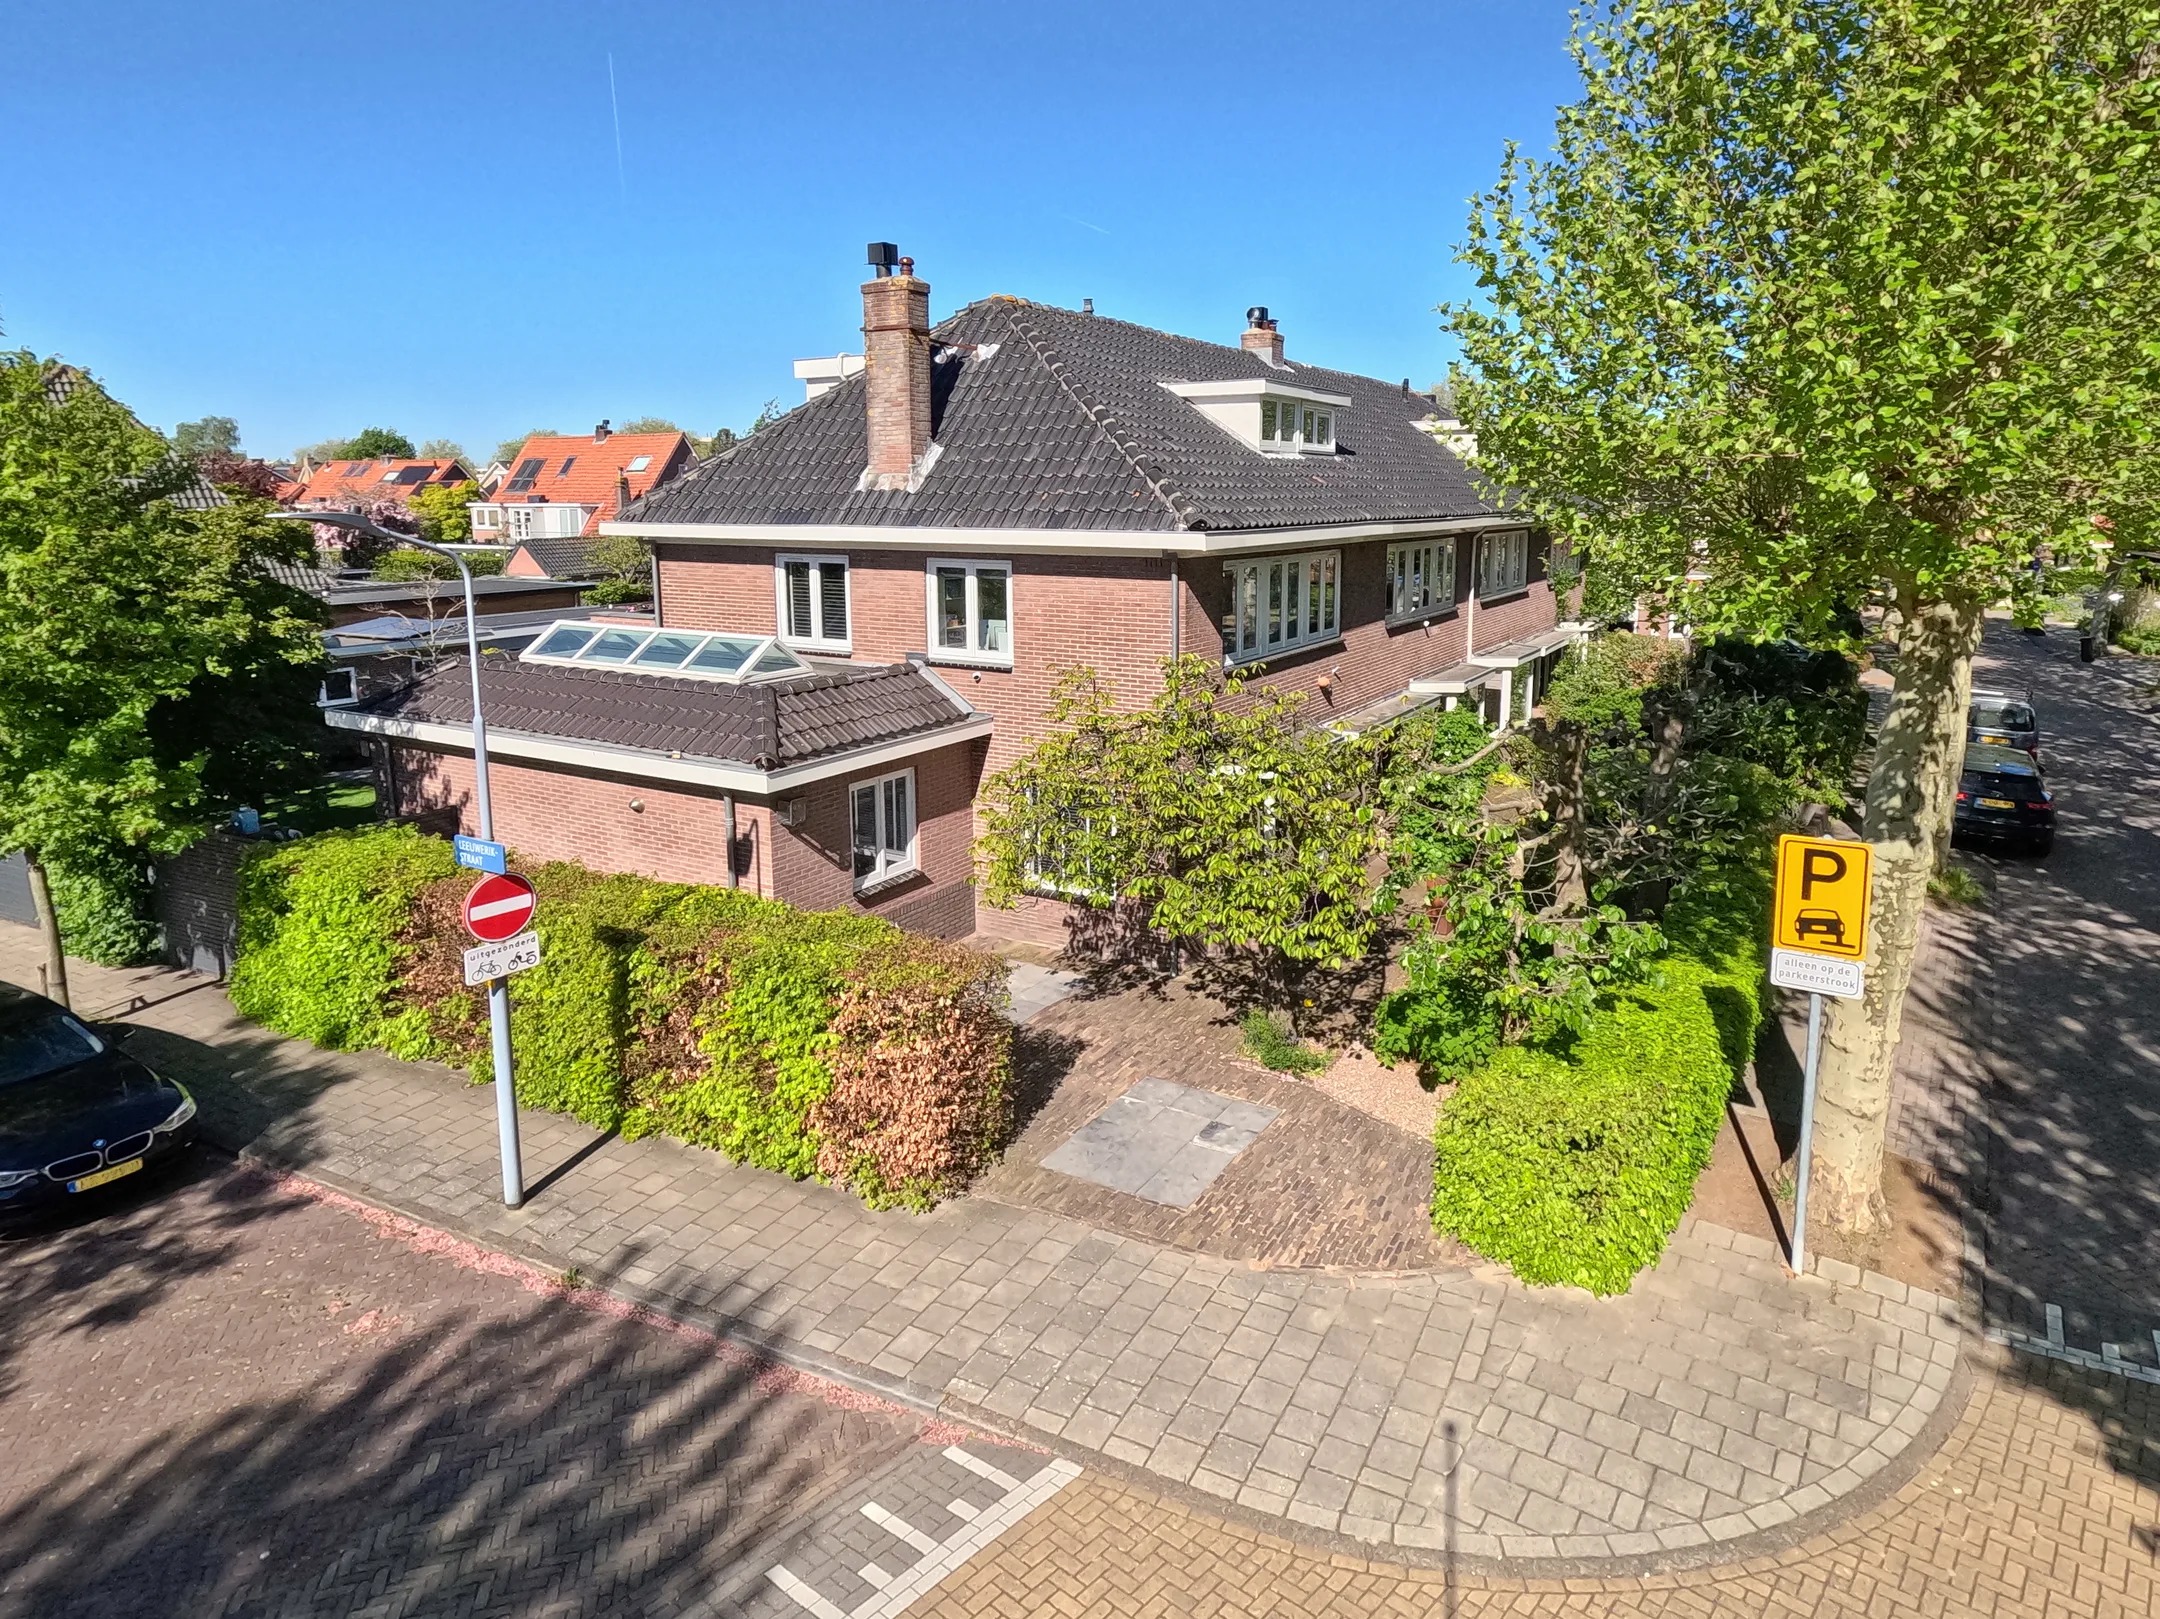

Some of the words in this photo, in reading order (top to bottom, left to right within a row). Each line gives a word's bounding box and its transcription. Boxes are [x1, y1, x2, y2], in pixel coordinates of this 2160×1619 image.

[460, 852, 483, 866] STRAAT
[1801, 848, 1847, 901] P
[470, 936, 536, 962] uitgezonderd
[1784, 959, 1817, 971] alleen
[1821, 965, 1834, 975] op
[1838, 967, 1851, 977] de
[1779, 970, 1856, 989] parkeerstrook
